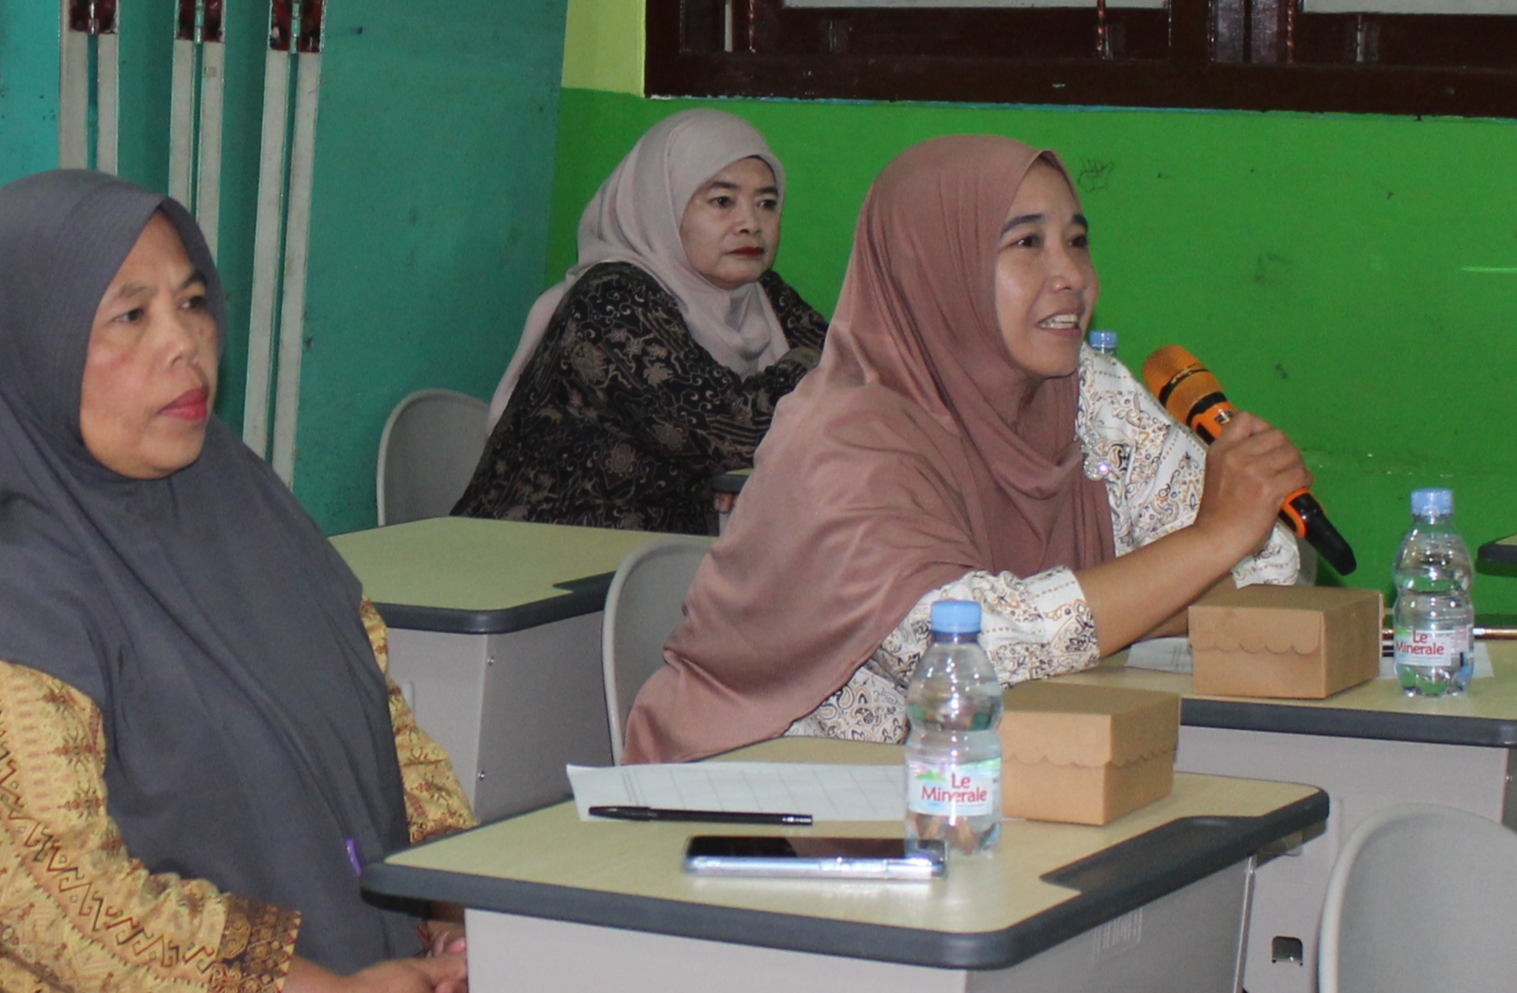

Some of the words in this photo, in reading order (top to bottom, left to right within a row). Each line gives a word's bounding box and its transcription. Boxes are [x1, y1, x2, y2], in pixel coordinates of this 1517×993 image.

[1412, 629, 1428, 644] Le
[1396, 641, 1445, 655] Minerale
[951, 772, 971, 789] Le
[921, 785, 988, 803] Minerale
